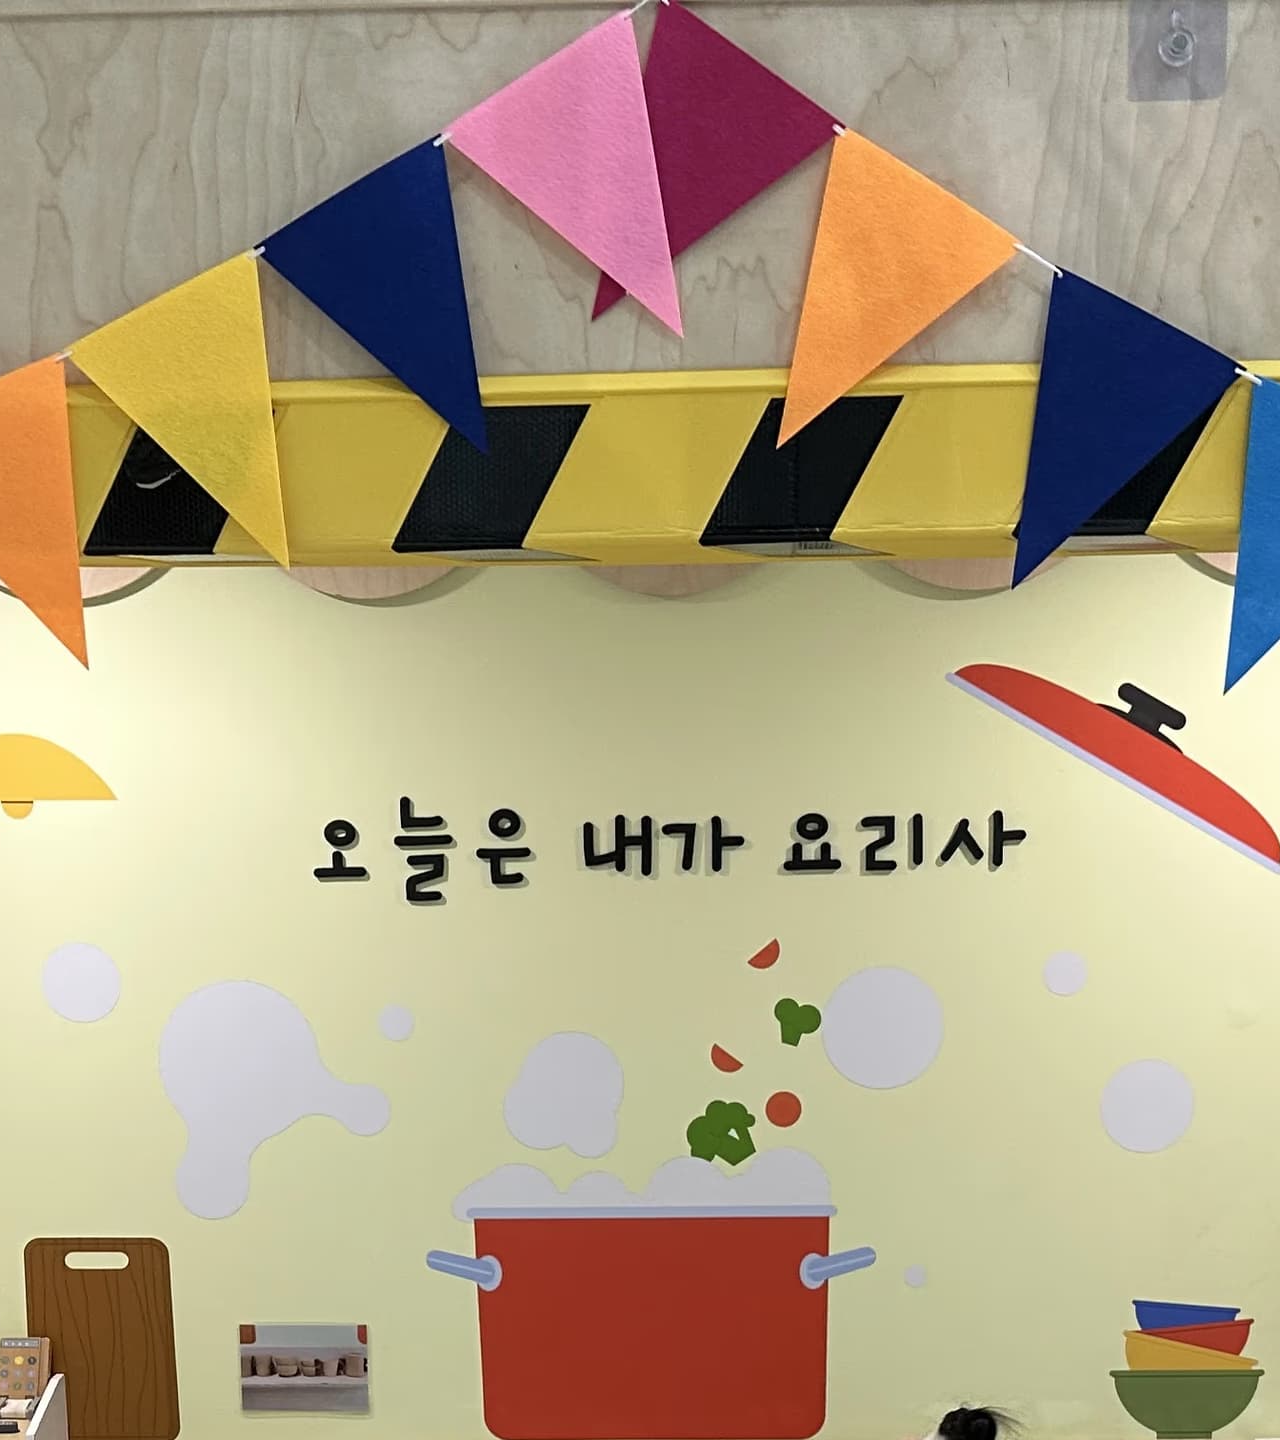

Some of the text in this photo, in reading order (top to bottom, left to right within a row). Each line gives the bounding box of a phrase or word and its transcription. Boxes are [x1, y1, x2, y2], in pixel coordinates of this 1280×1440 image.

[313, 796, 1027, 901] 오늘은 내가 요리사
